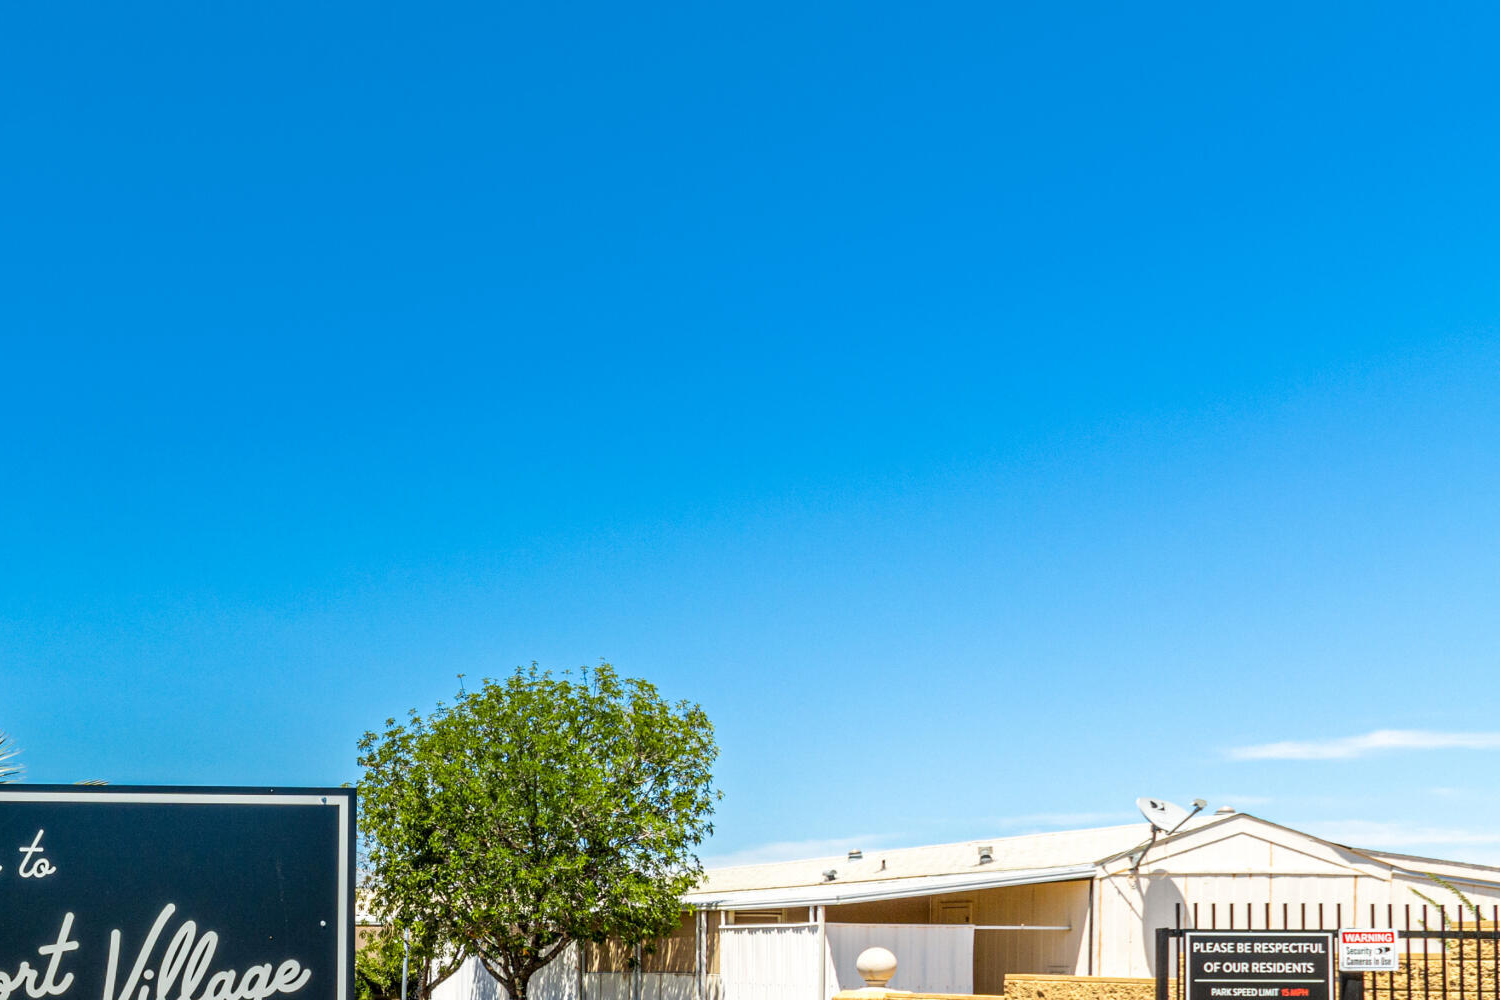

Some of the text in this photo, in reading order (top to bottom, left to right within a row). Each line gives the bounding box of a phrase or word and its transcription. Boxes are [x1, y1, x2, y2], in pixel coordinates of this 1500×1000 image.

[19, 829, 57, 878] to
[1344, 933, 1393, 943] WARNING
[1192, 942, 1326, 954] PLEASE BE RESPECTFUL
[1346, 946, 1372, 957] Security
[1203, 962, 1315, 974] OF OUR RESIDENTS
[1210, 988, 1232, 997] PARK
[1232, 988, 1258, 997] SPEED
[1258, 988, 1279, 997] LIMIT
